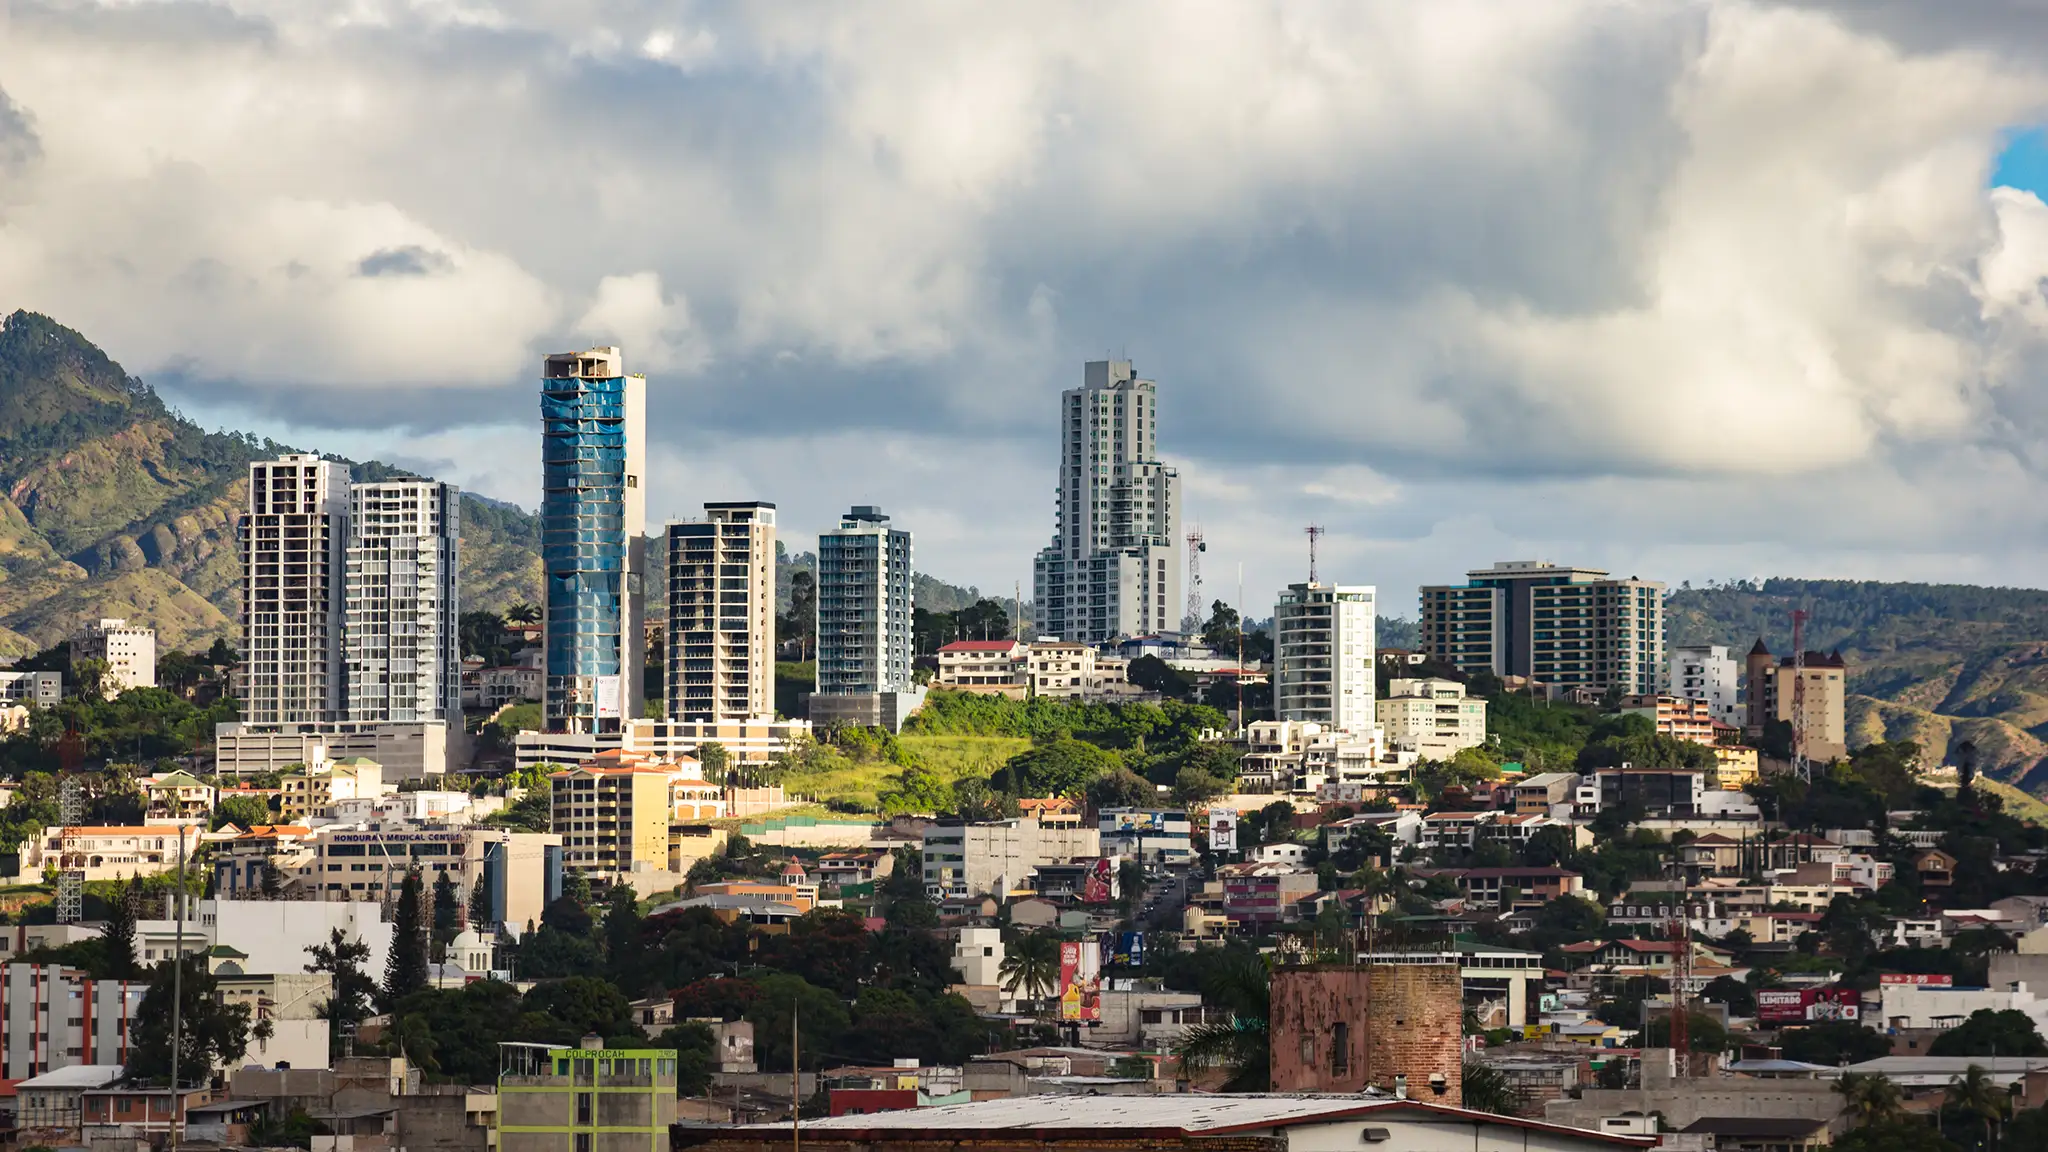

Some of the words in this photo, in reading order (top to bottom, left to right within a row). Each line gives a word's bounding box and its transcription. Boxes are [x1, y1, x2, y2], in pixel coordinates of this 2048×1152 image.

[333, 834, 383, 842] HONDURAS
[386, 834, 424, 842] MEDICAL
[565, 1050, 625, 1059] COLPROCAH
